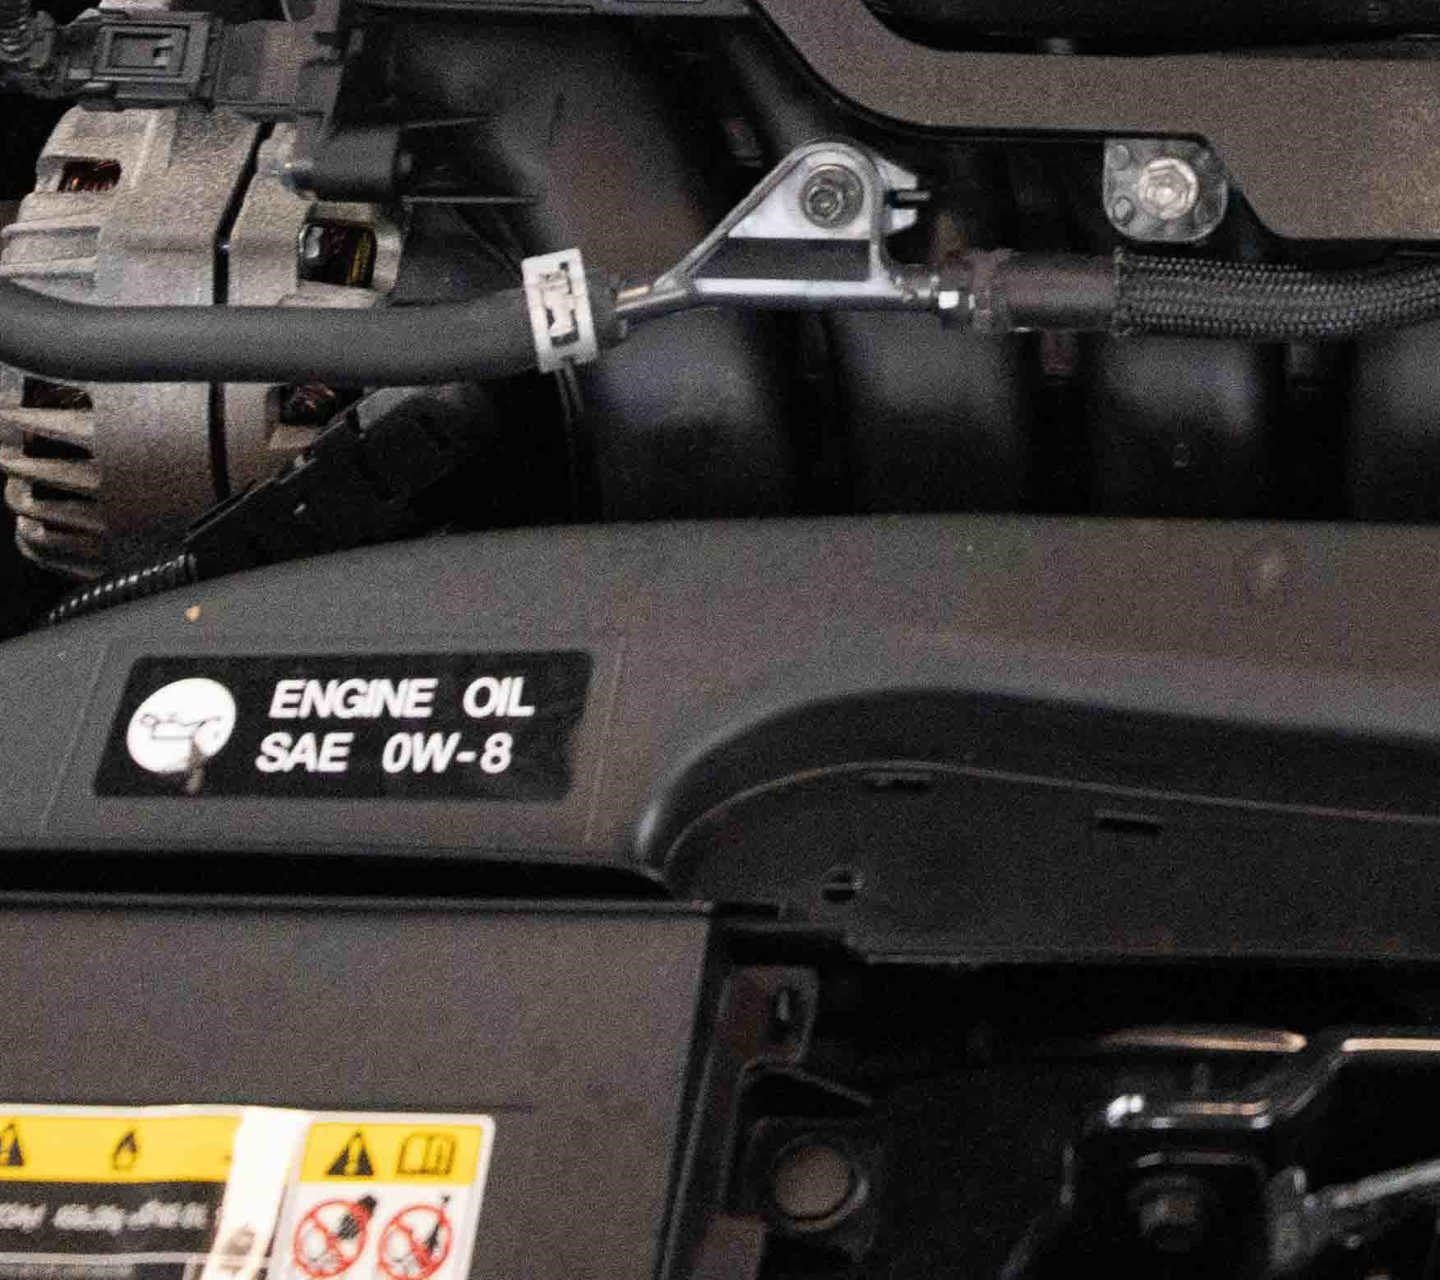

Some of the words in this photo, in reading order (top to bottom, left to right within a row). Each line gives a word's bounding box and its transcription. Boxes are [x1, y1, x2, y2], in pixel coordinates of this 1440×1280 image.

[268, 677, 439, 719] ENGINE
[463, 675, 537, 718] OIL
[254, 732, 354, 774] SAE
[381, 732, 514, 775] 0W-8
